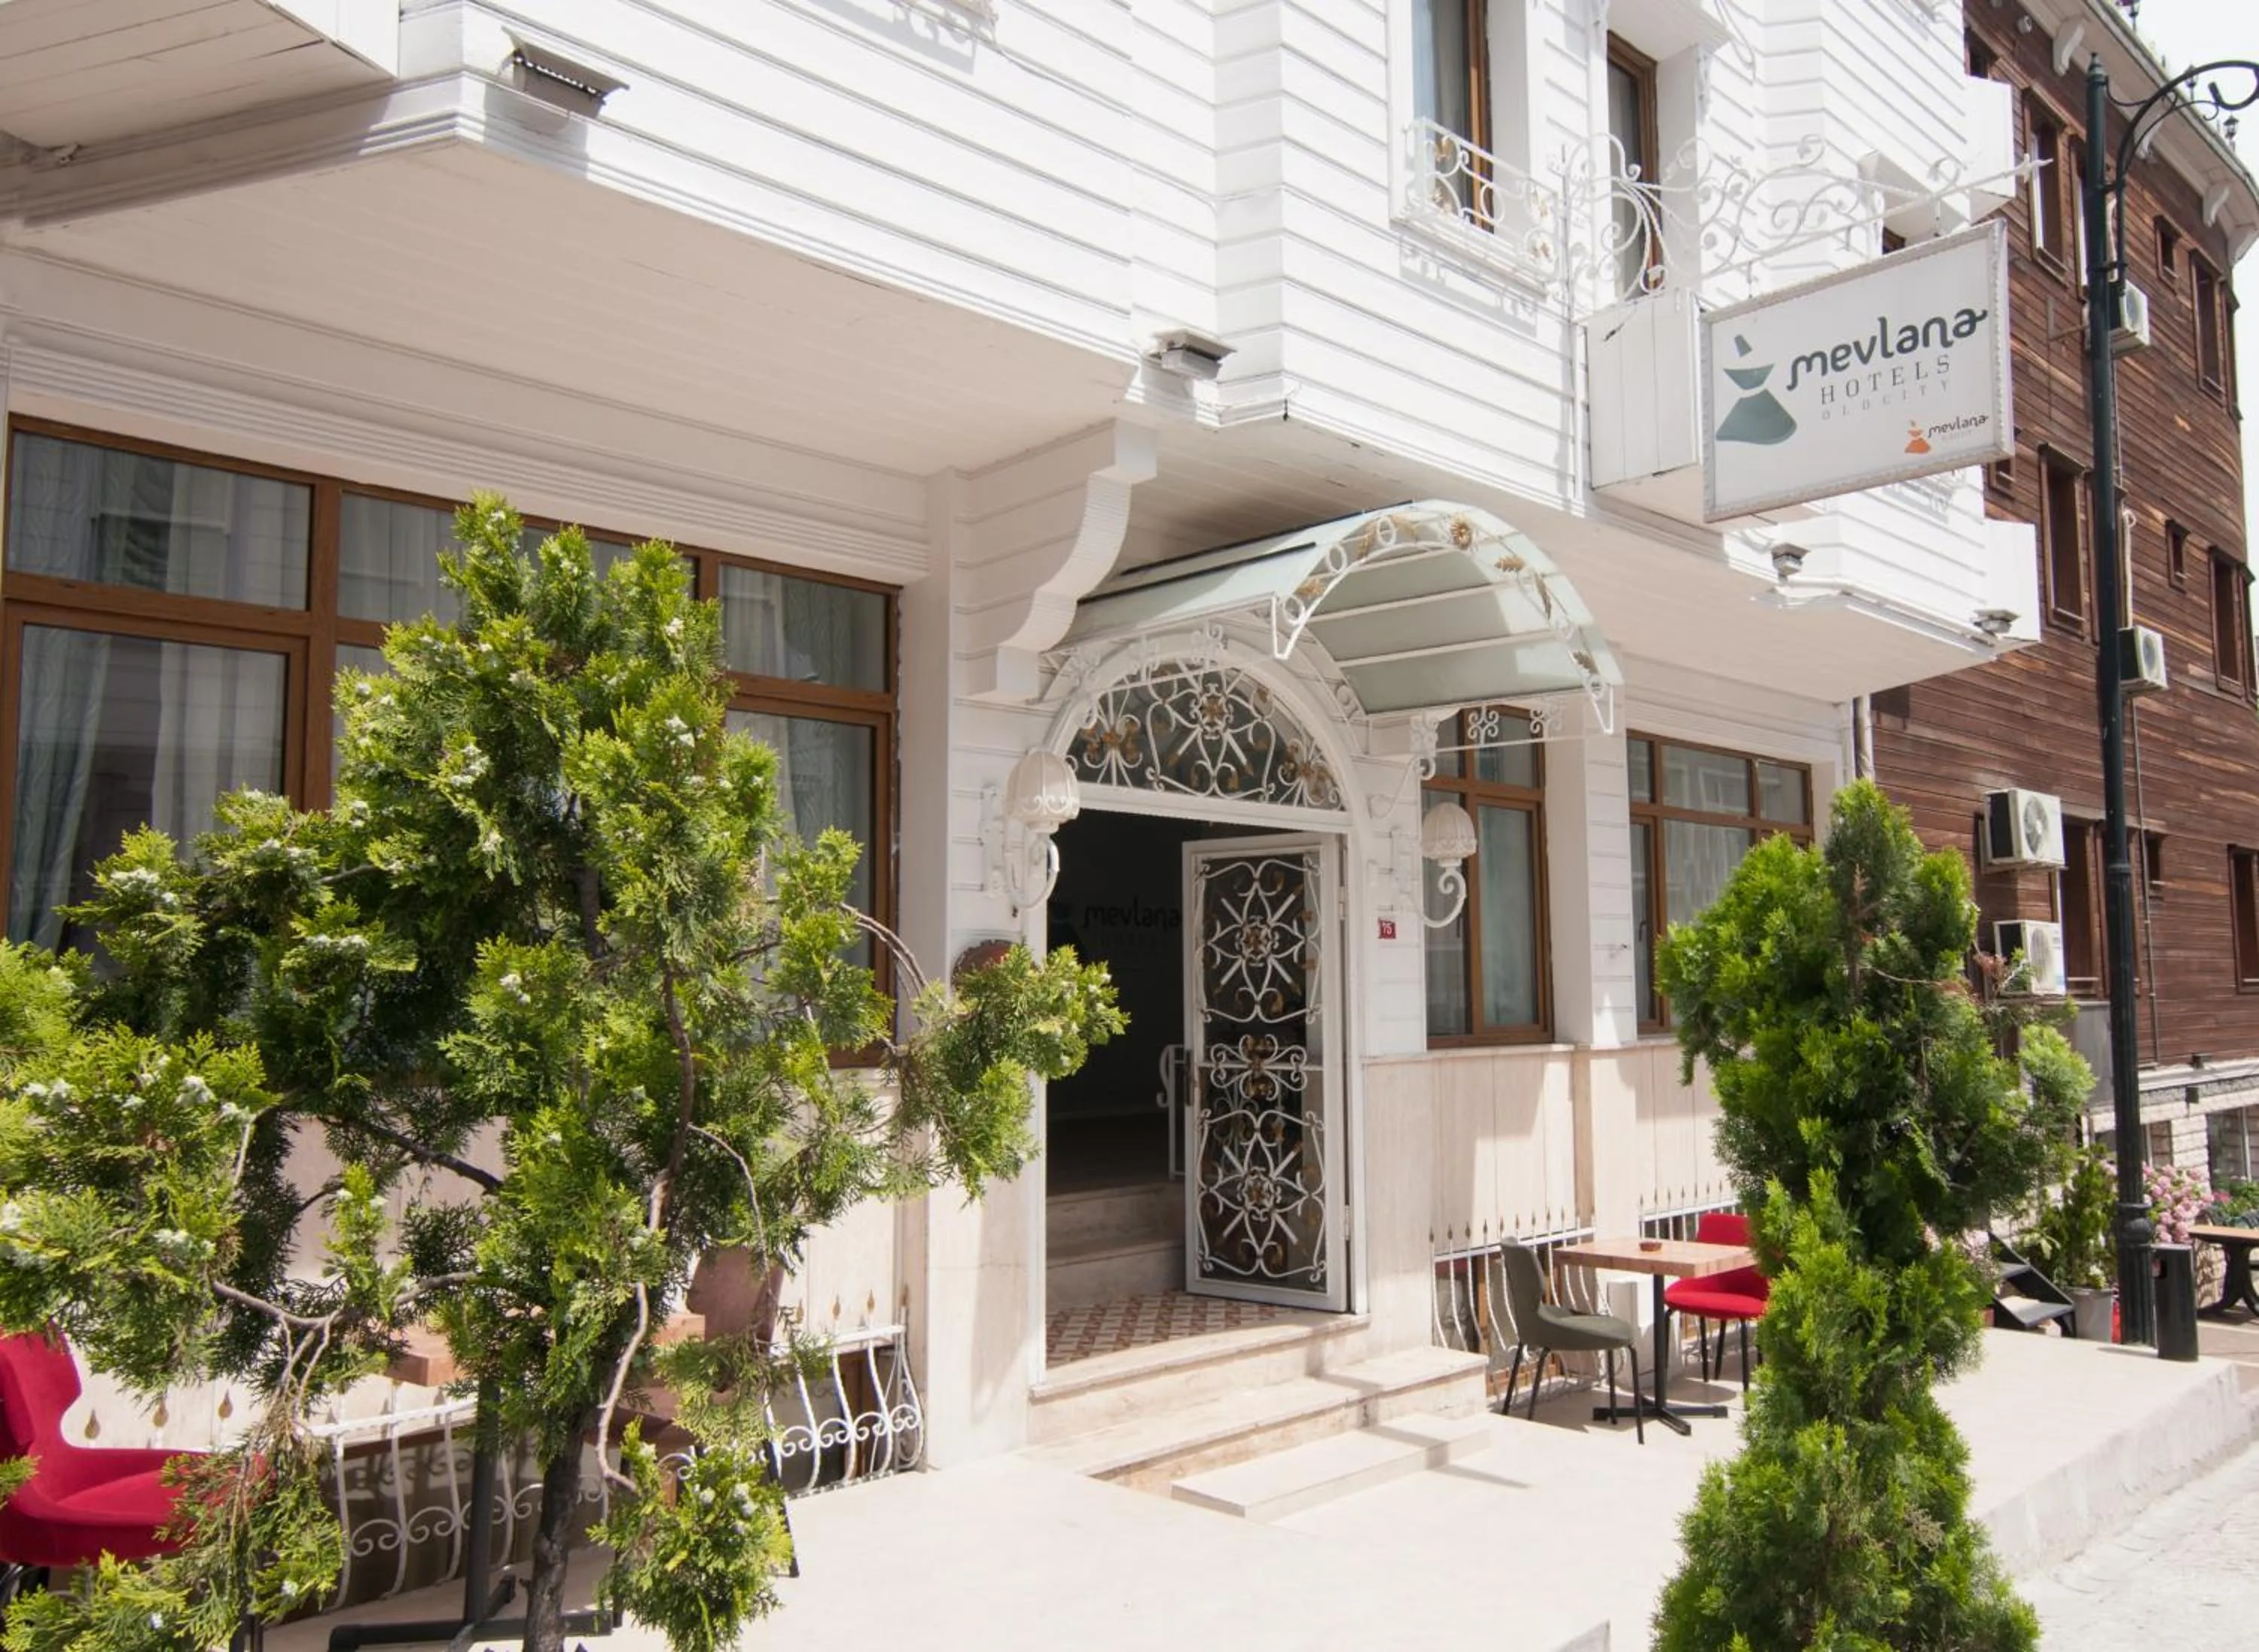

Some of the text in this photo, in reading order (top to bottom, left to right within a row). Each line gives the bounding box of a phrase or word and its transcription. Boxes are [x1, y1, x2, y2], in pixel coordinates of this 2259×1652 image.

[1786, 308, 1988, 391] mevlana
[1821, 354, 1951, 405] HOTELS
[1927, 416, 1989, 438] mevlana
